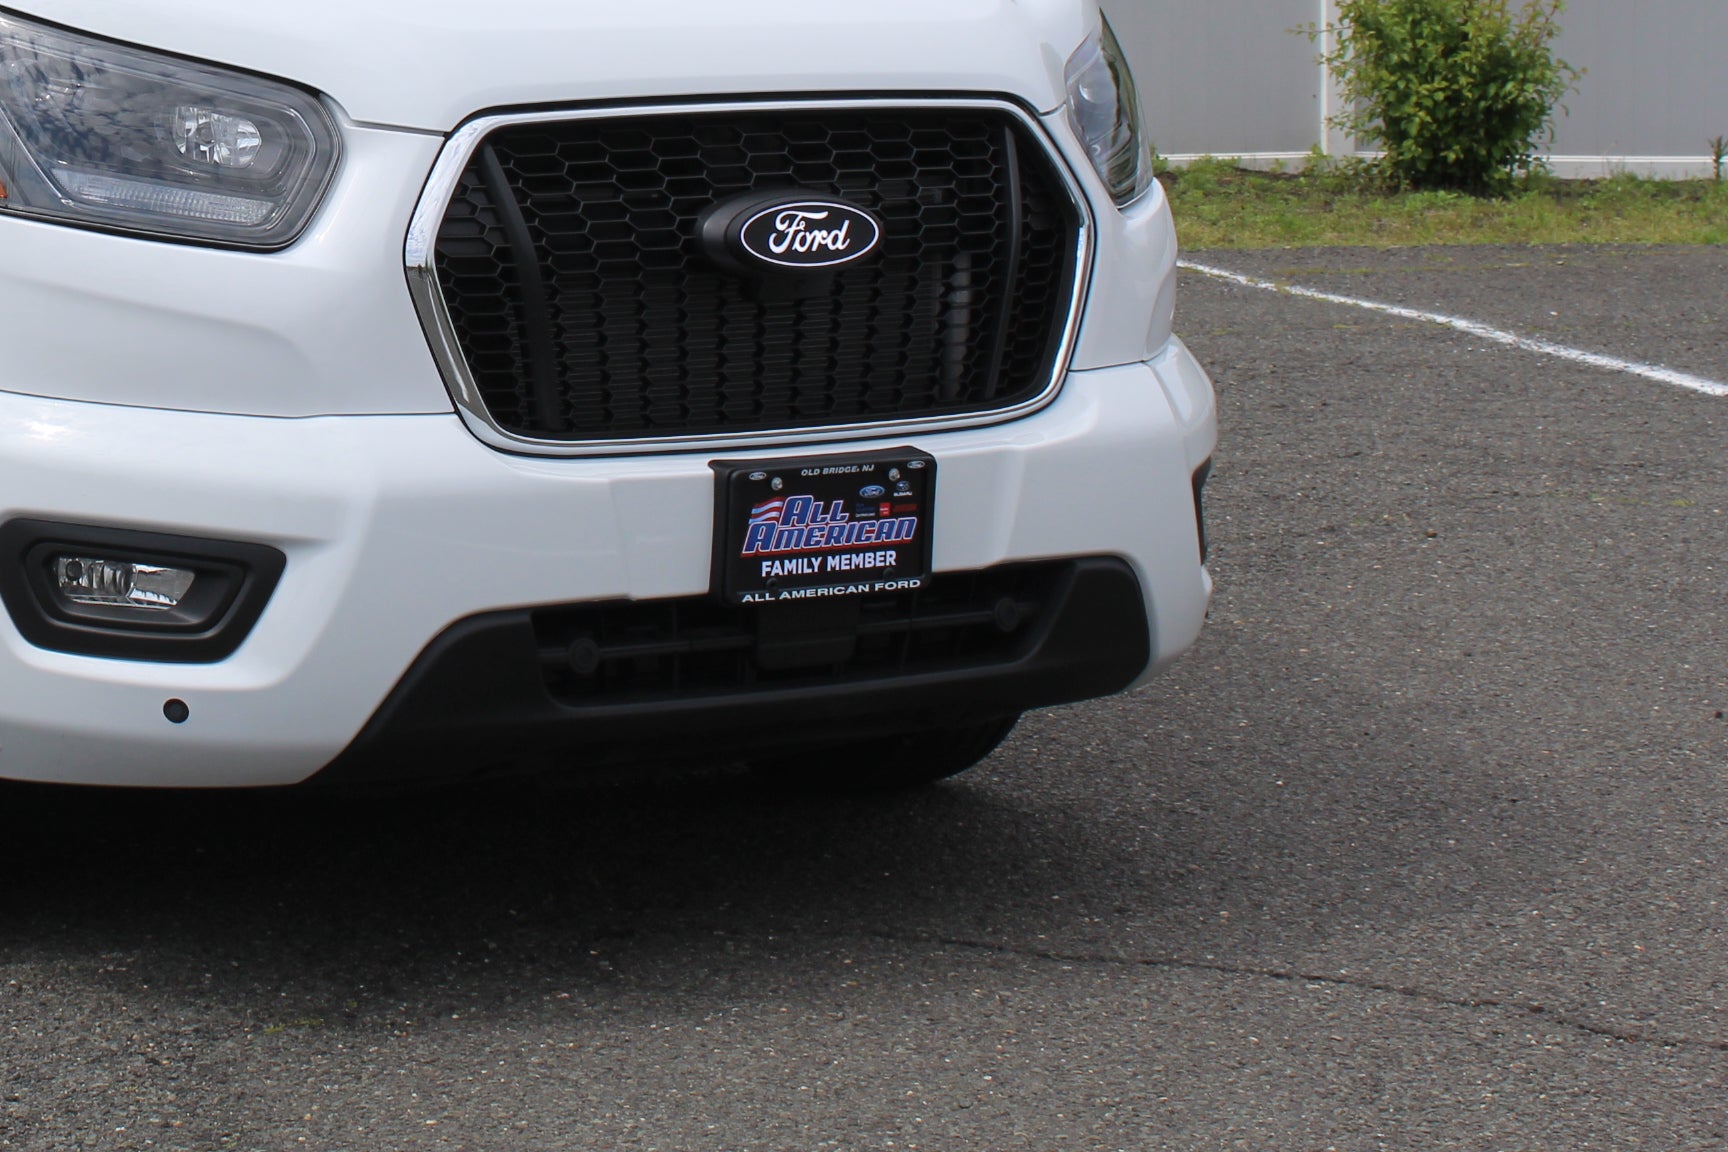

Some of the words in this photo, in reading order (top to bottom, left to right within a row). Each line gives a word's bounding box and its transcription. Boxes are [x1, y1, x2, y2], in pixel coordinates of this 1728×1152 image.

[768, 210, 850, 254] Ford
[801, 468, 820, 477] OLD
[862, 464, 875, 472] NJ
[742, 517, 918, 555] AMERICAN
[761, 556, 823, 577] FAMILY
[826, 550, 897, 572] MEMBER
[741, 592, 776, 603] ALL
[779, 584, 870, 600] AMERICAN
[874, 579, 921, 592] FORD
